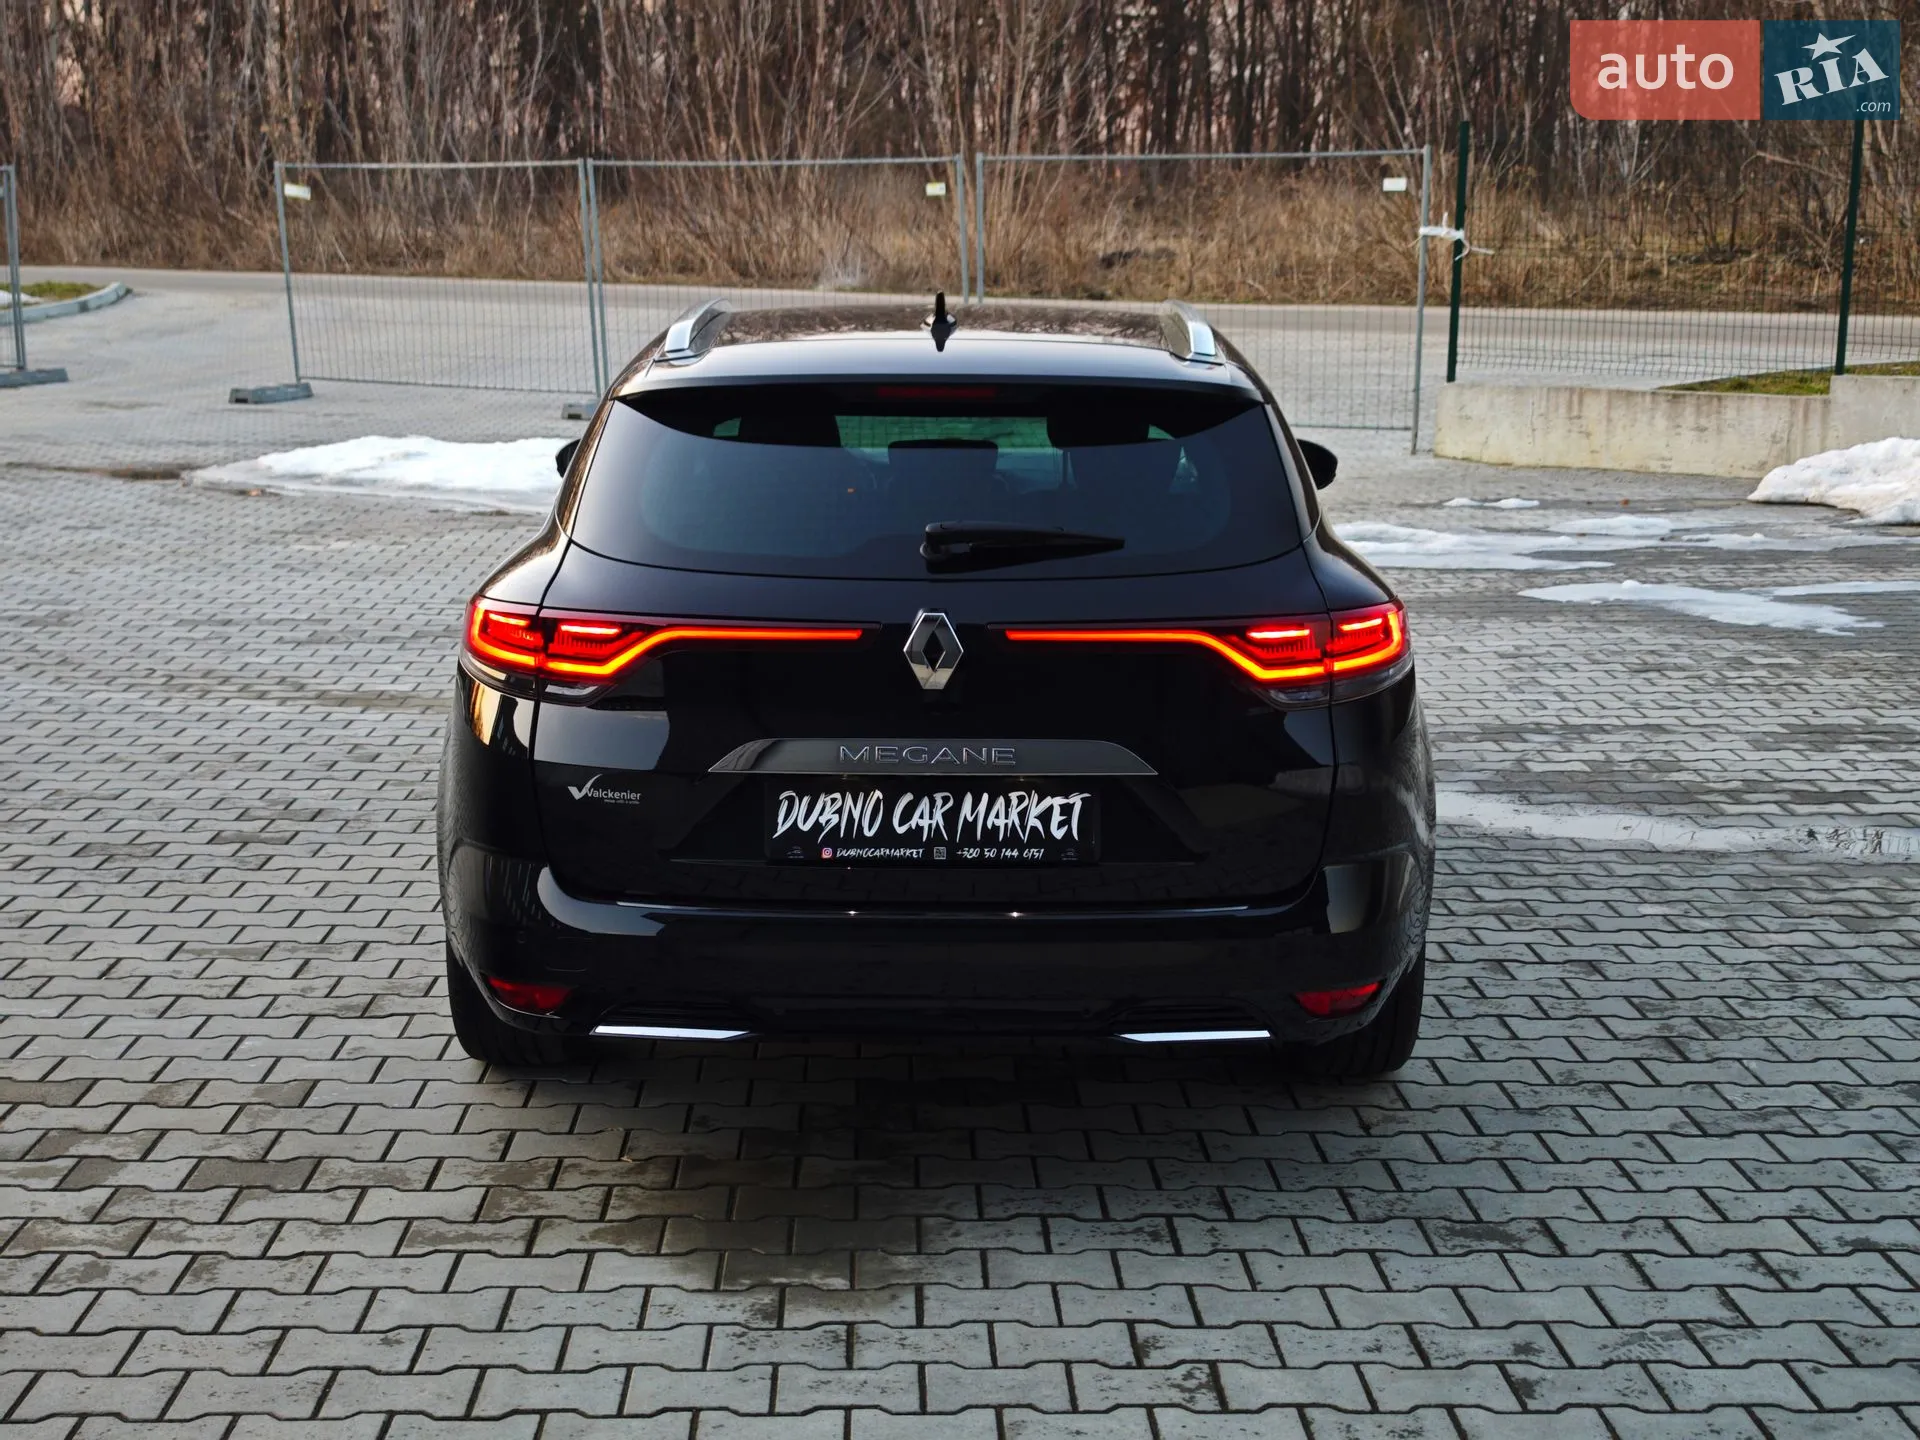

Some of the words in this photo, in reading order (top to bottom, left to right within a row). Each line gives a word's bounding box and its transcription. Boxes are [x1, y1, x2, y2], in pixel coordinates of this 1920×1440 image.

[839, 745, 1017, 766] MEGANE
[772, 789, 884, 844] DUBNO
[892, 791, 954, 843] CAR
[956, 789, 1092, 844] MARKET
[836, 847, 925, 859] DUBNOCARMARKET
[956, 847, 980, 859] +380
[984, 847, 998, 859] 50
[1000, 847, 1019, 860] 144
